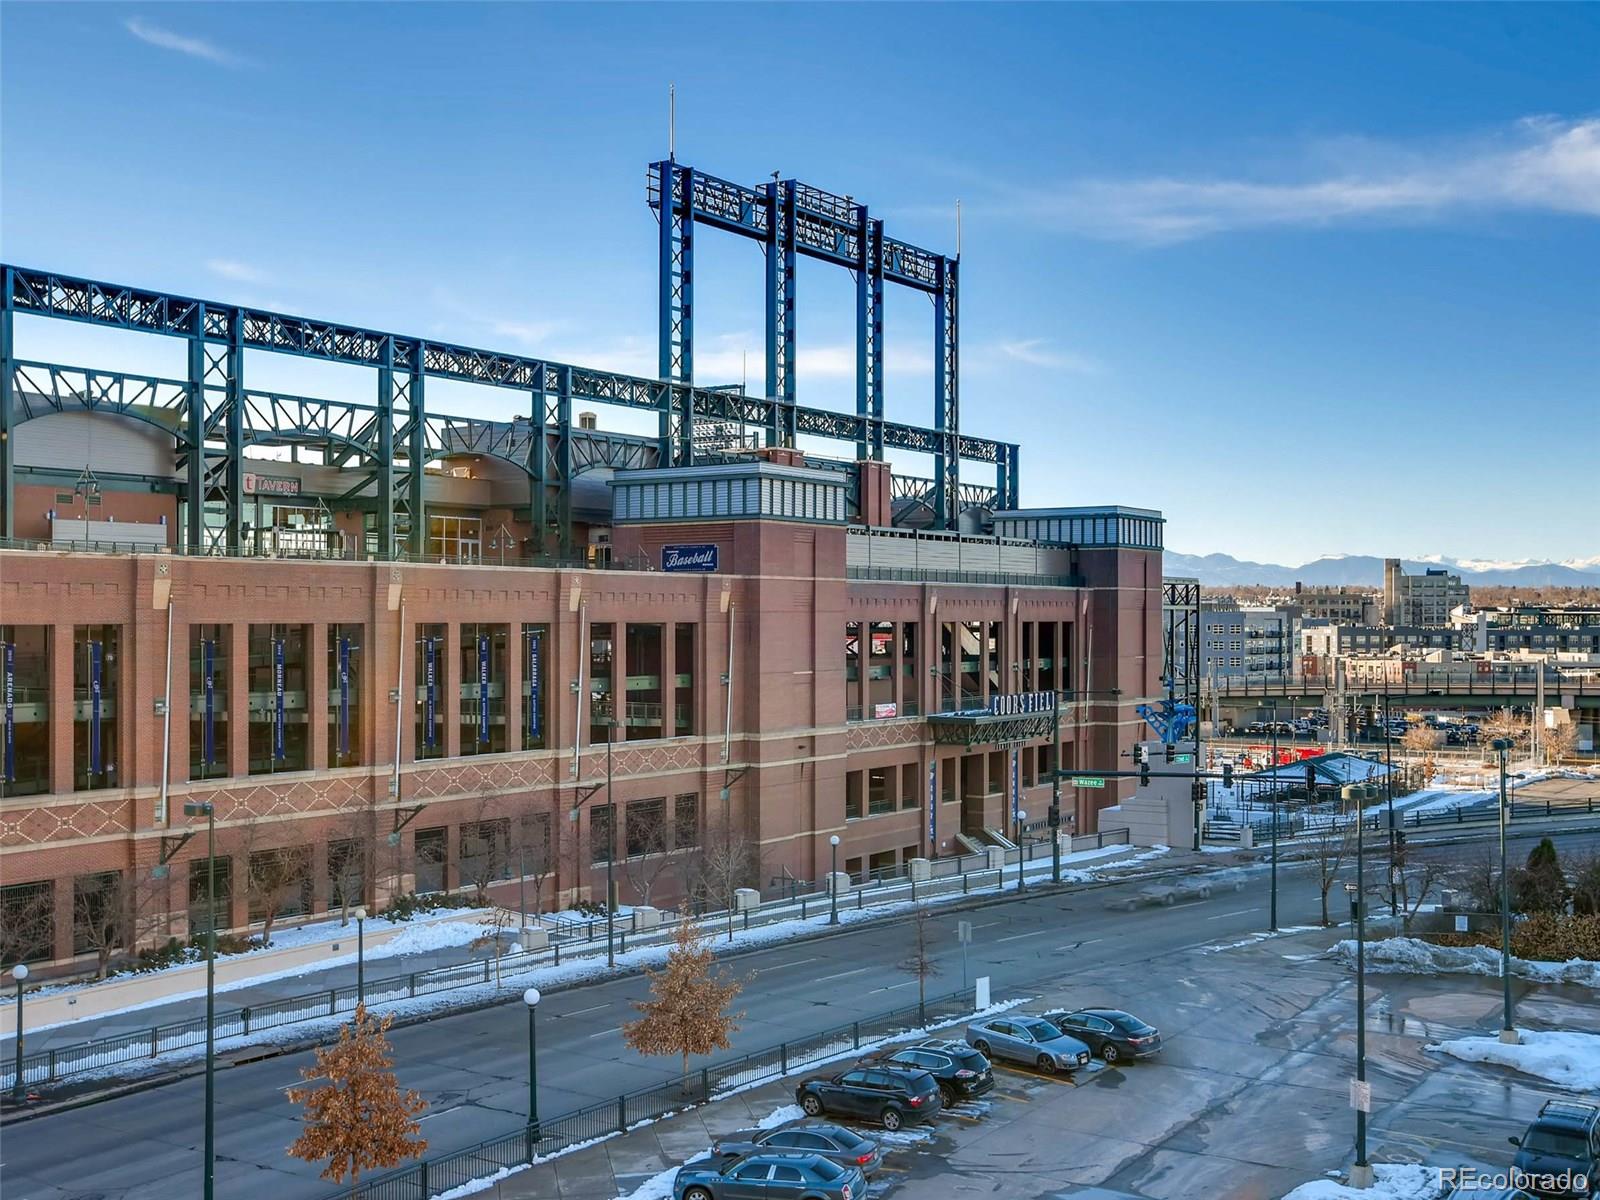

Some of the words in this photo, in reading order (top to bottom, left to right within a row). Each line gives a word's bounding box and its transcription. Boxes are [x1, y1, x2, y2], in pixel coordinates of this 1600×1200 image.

[255, 475, 299, 493] TAVERN
[666, 550, 714, 568] Baseball
[994, 694, 1025, 716] COORS
[1079, 778, 1098, 786] Wazee
